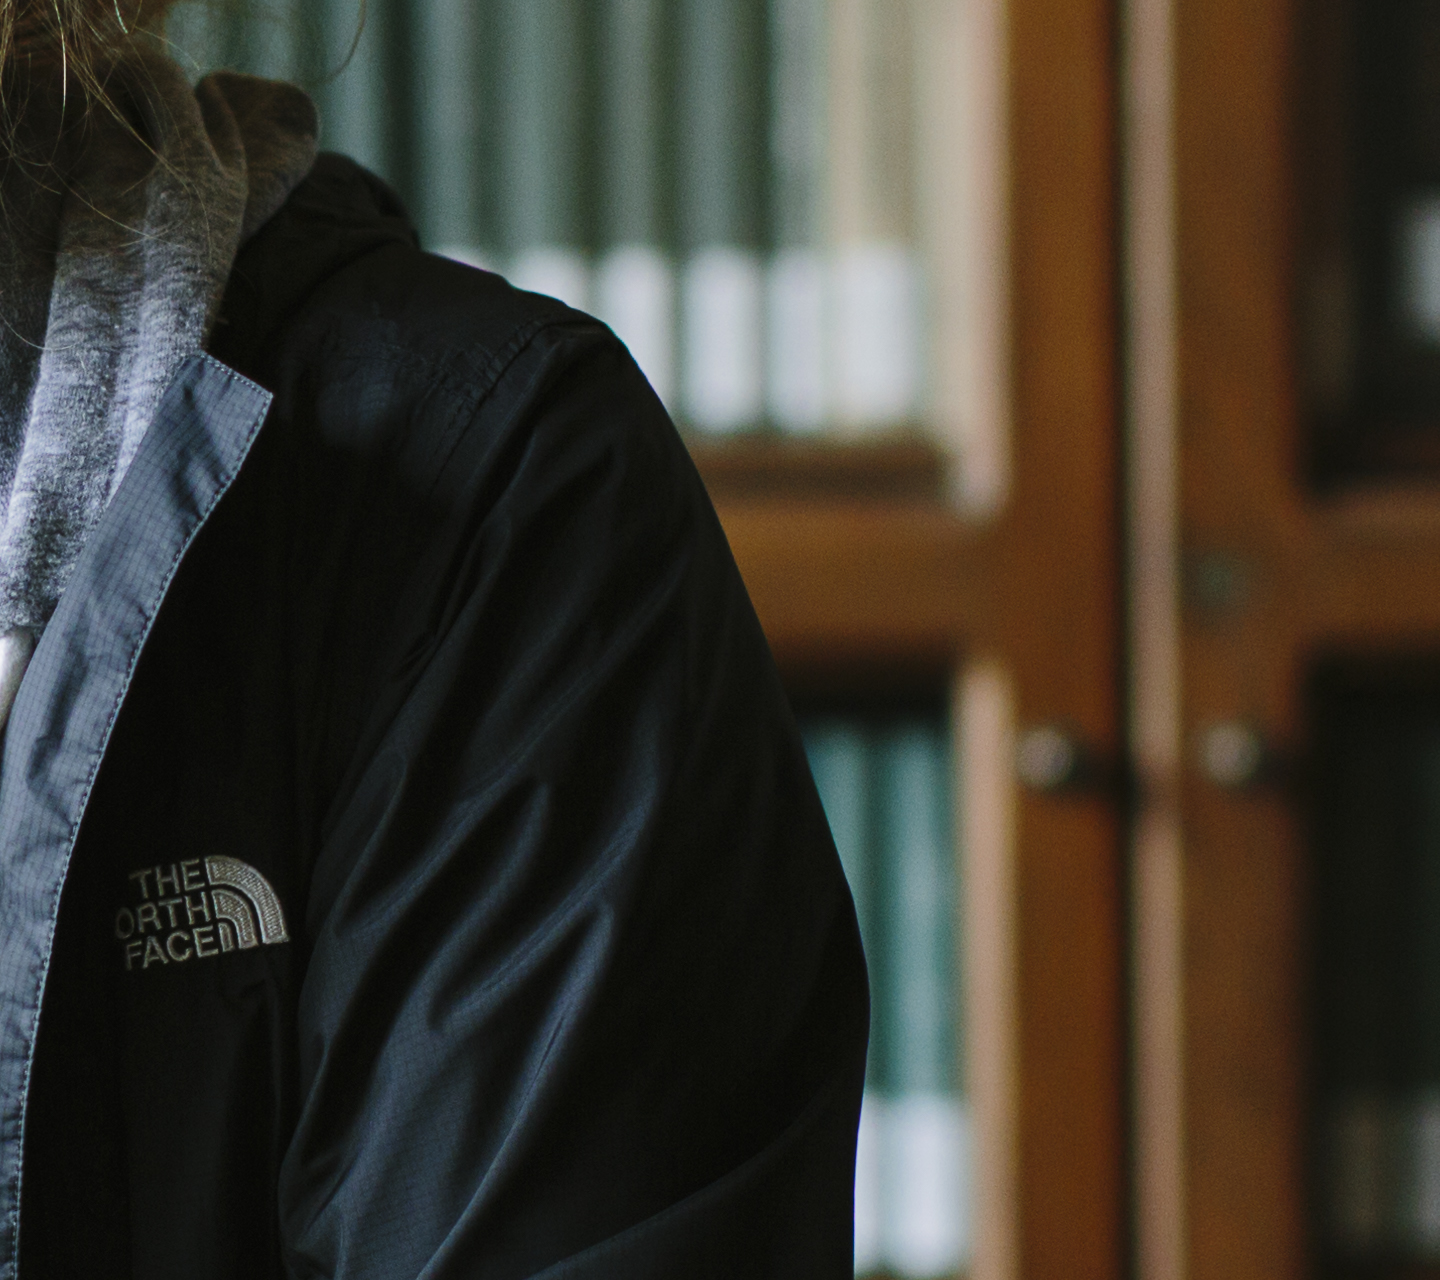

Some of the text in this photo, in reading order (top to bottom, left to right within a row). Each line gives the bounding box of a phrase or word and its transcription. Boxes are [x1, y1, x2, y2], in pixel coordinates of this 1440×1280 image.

[129, 858, 206, 899] THE
[115, 891, 212, 940] ORTH
[124, 924, 219, 971] FACE
